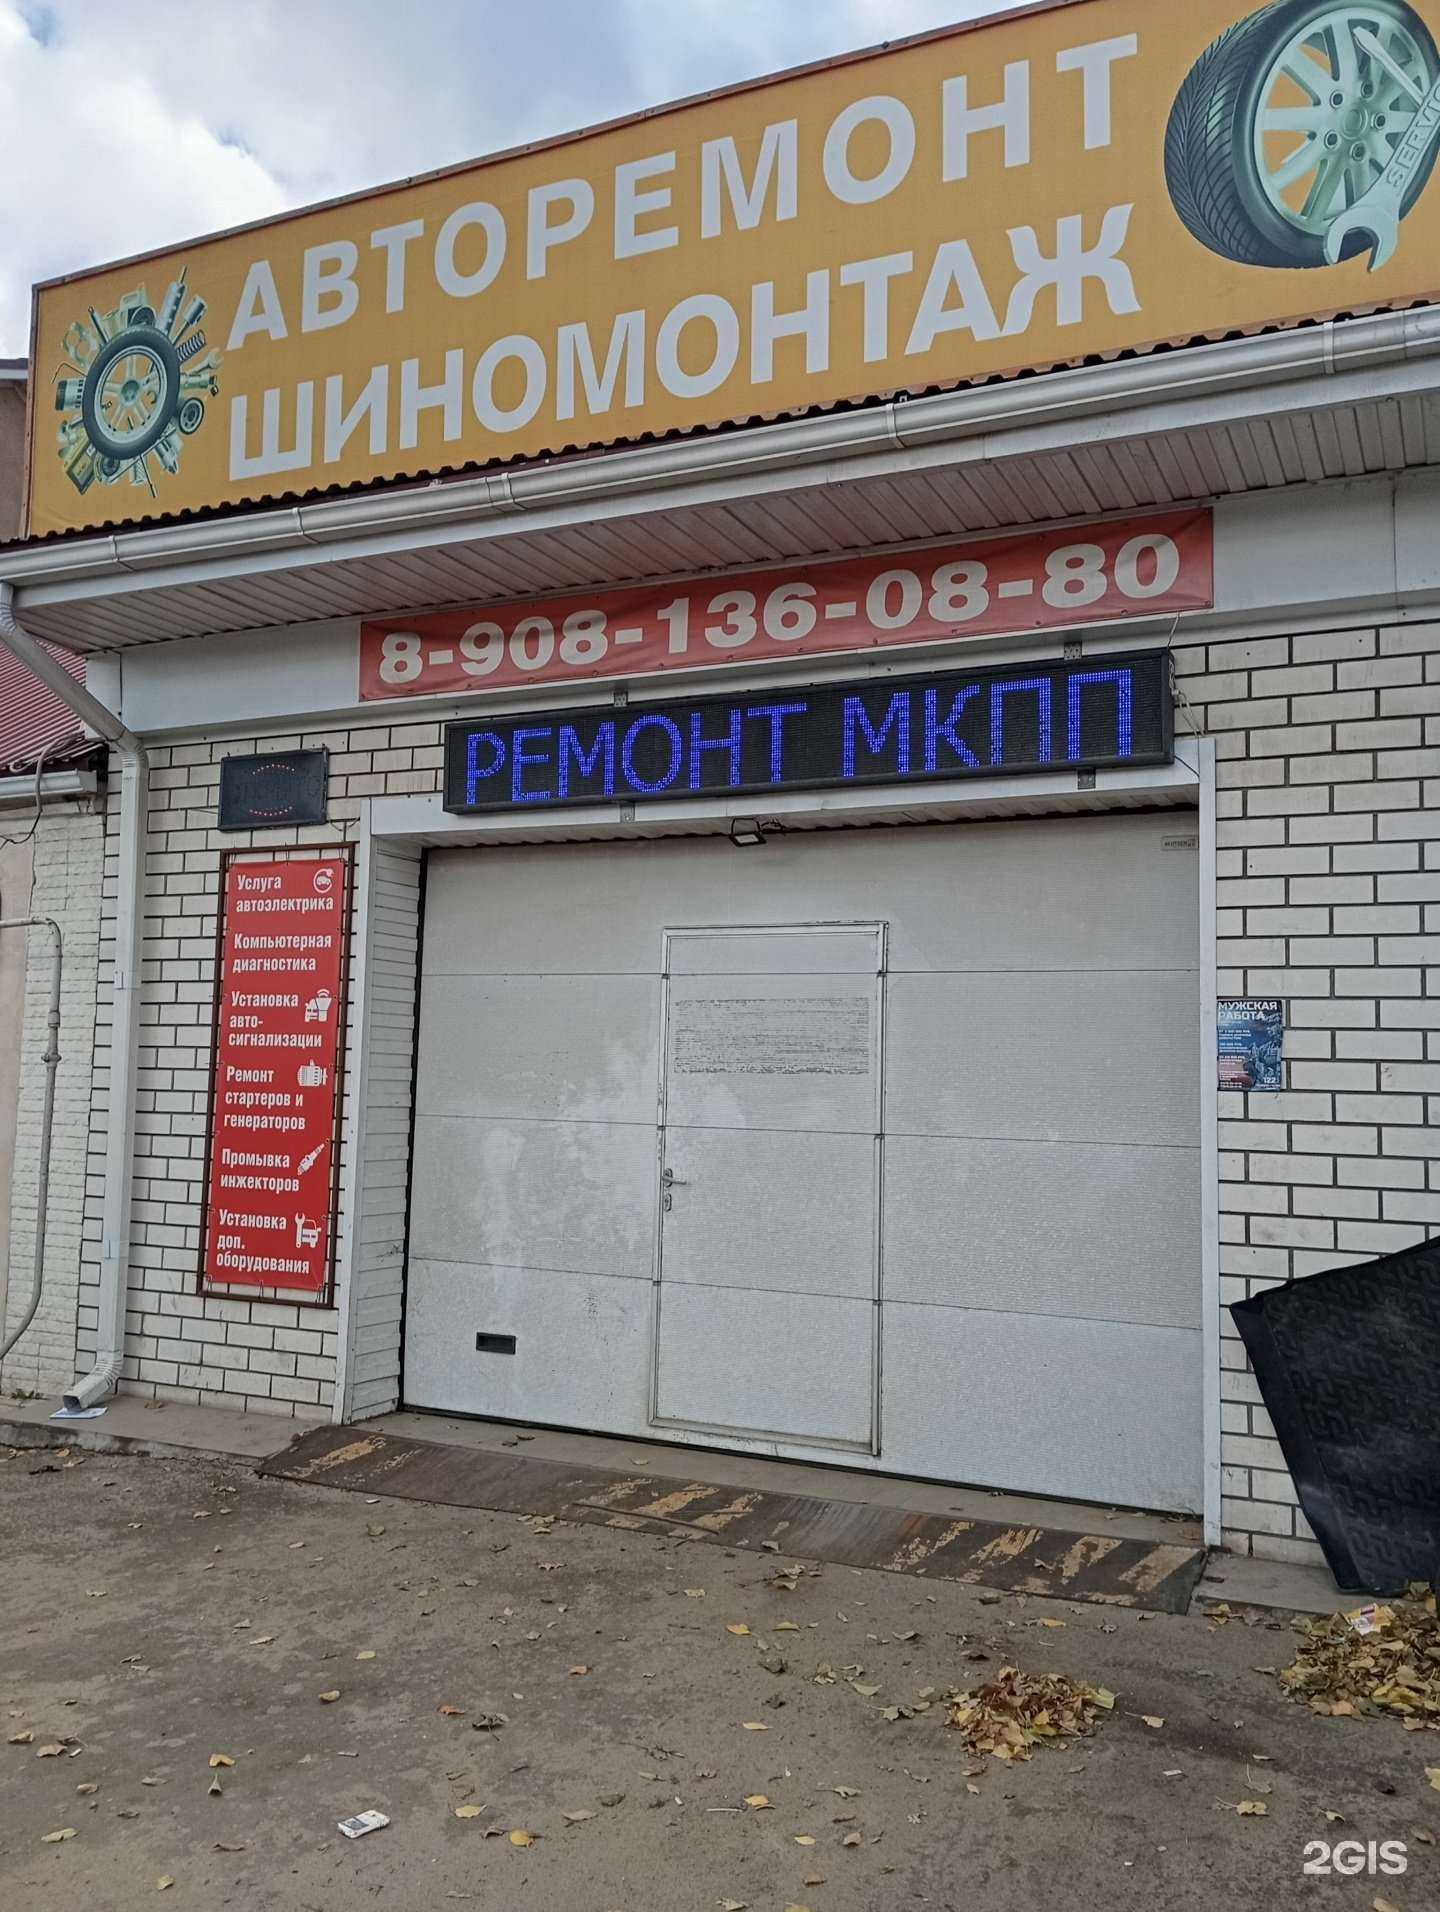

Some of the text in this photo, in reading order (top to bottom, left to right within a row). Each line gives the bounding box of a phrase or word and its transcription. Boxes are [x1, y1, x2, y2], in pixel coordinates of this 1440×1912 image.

[227, 33, 1138, 351] АВТОРЕМОНТ
[228, 203, 1142, 481] ШИНОМОНТАЖ
[378, 533, 1181, 686] 8-908-136-08-80
[465, 668, 1133, 806] РЕМОНТ МКПП
[237, 875, 282, 891] Услуга
[236, 897, 333, 914] автоэлектрика
[234, 934, 332, 950] Компьютерная
[233, 957, 316, 973] диагностика
[231, 991, 299, 1007] Установка
[1218, 1001, 1278, 1011] МУЖСКАЯ
[230, 1015, 264, 1028] авто-
[1218, 1011, 1266, 1020] РАБОТА
[228, 1034, 321, 1049] сигнализации
[226, 1066, 274, 1083] Ремонт
[225, 1092, 303, 1109] стартеров и
[224, 1114, 306, 1132] генераторов
[222, 1148, 290, 1168] Промывка
[220, 1174, 300, 1193] инжекторов
[219, 1209, 287, 1229] Установка
[217, 1234, 245, 1250] доп.
[216, 1251, 309, 1273] оборудования
